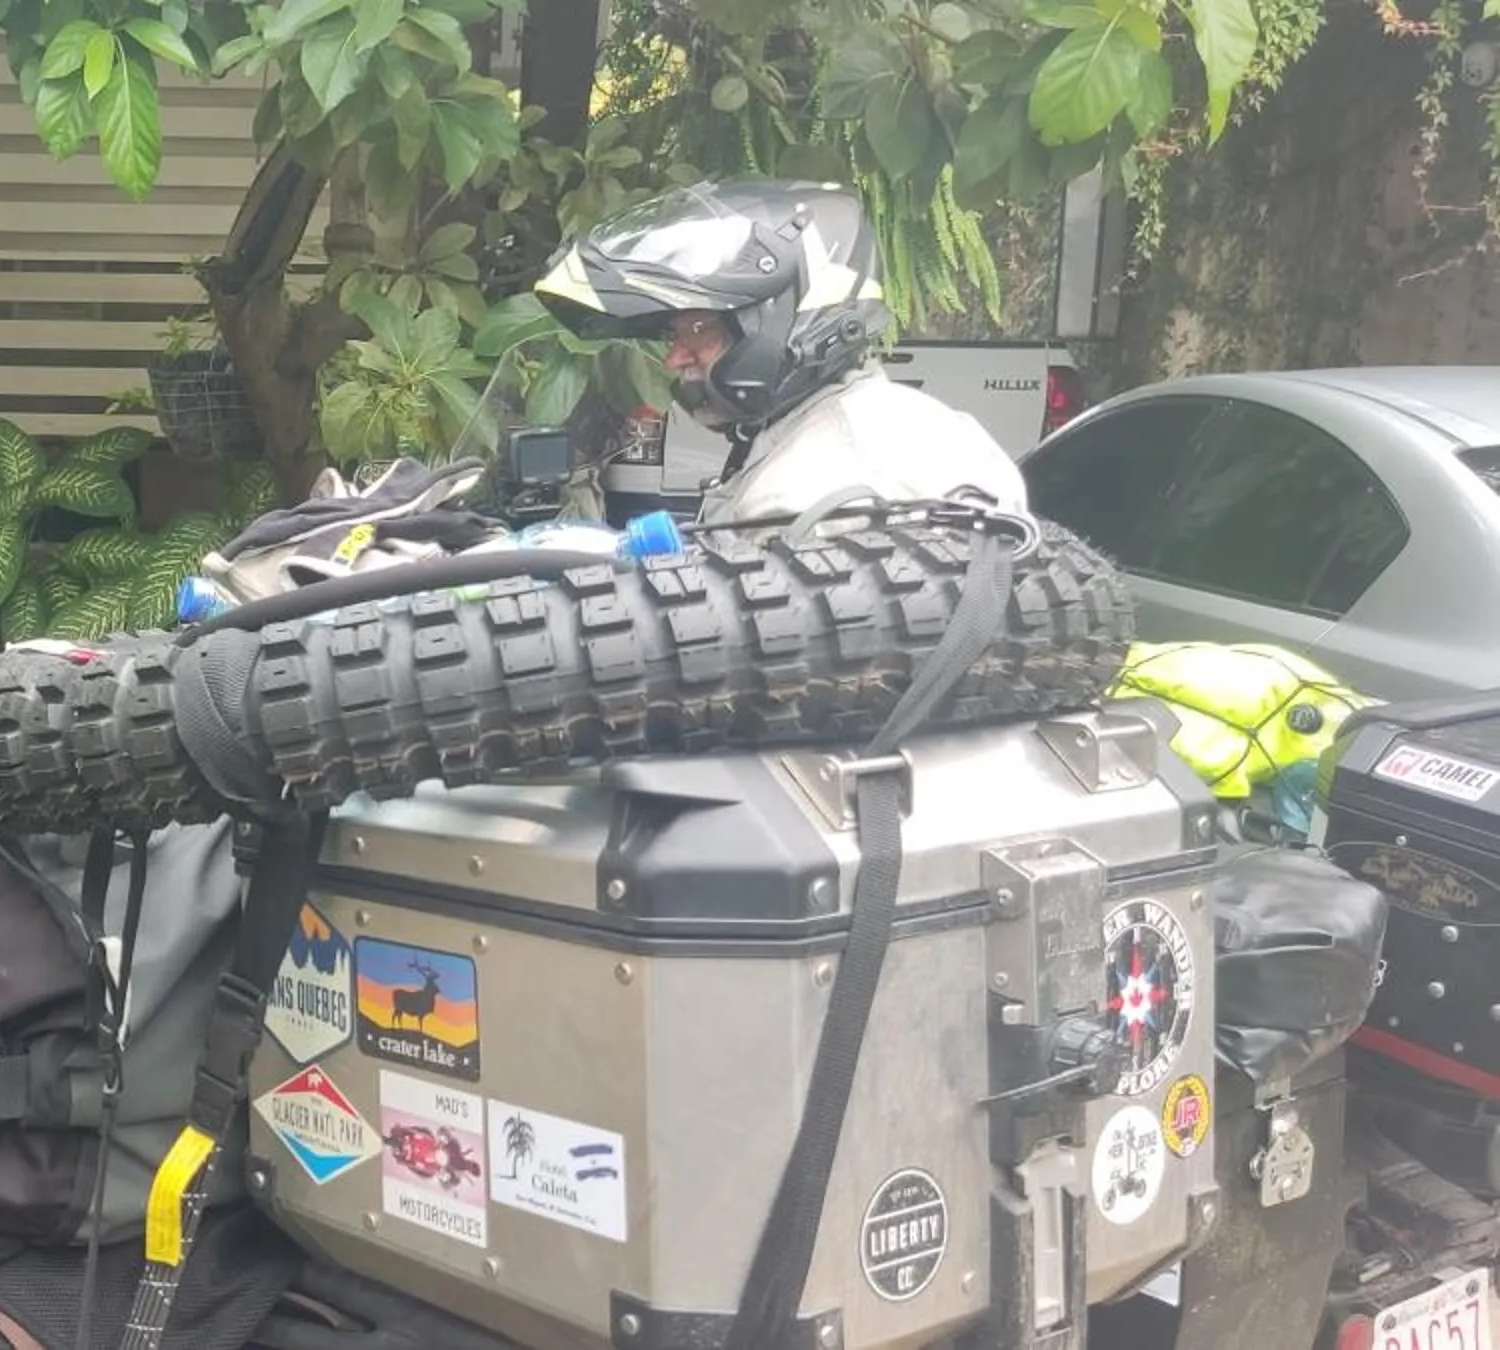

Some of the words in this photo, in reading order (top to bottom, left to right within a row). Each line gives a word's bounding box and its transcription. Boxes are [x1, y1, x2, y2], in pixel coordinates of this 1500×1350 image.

[983, 378, 1041, 391] HILUX
[1419, 758, 1493, 790] CAMEL
[378, 1036, 420, 1059] crater
[423, 1040, 456, 1068] lake
[272, 1097, 311, 1131] GLACIER
[339, 1119, 364, 1147] PARK
[435, 1093, 469, 1119] MAD'S
[531, 1173, 578, 1204] Caleta
[399, 1193, 482, 1240] MOTORCYCLES
[870, 1213, 940, 1257] LIBERTY
